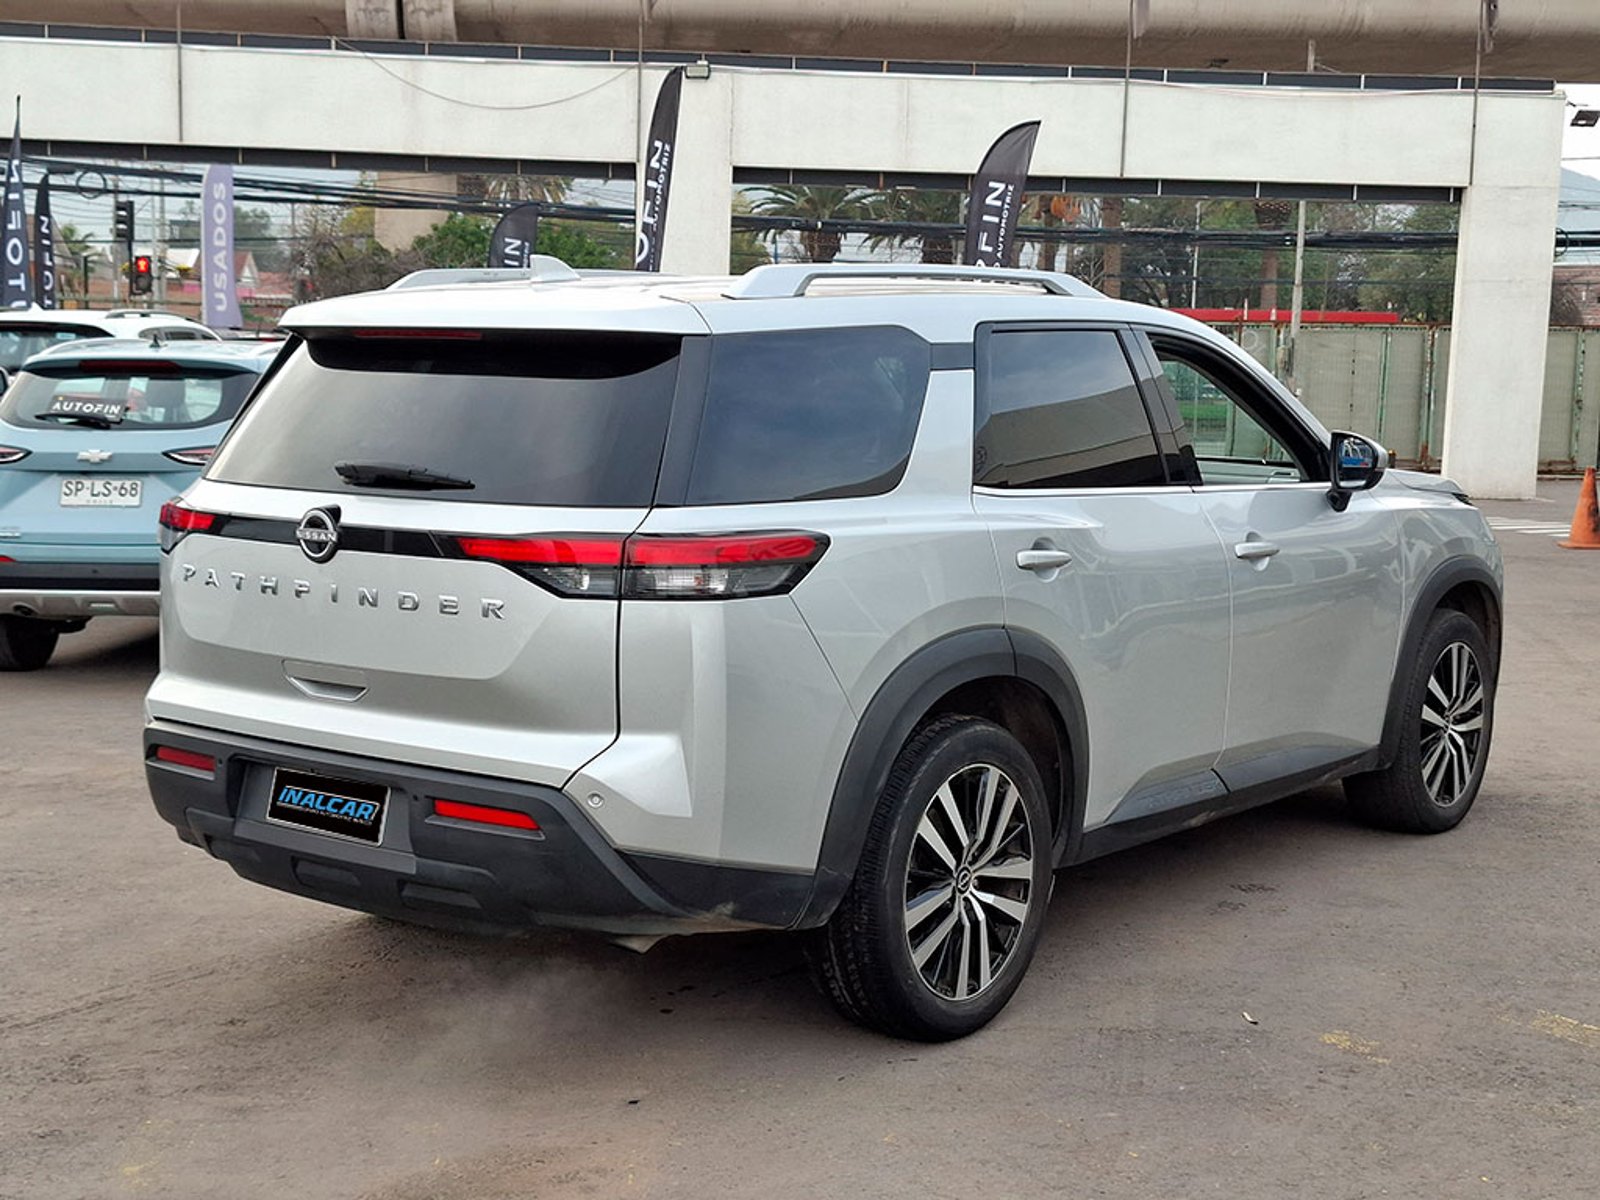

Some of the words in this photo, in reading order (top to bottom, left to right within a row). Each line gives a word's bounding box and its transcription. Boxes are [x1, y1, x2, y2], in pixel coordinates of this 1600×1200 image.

[212, 182, 229, 312] USADOS
[996, 184, 1015, 259] AUTOMOTRIZ
[52, 401, 121, 414] AUTOFIN
[182, 563, 506, 619] PATHFINDER
